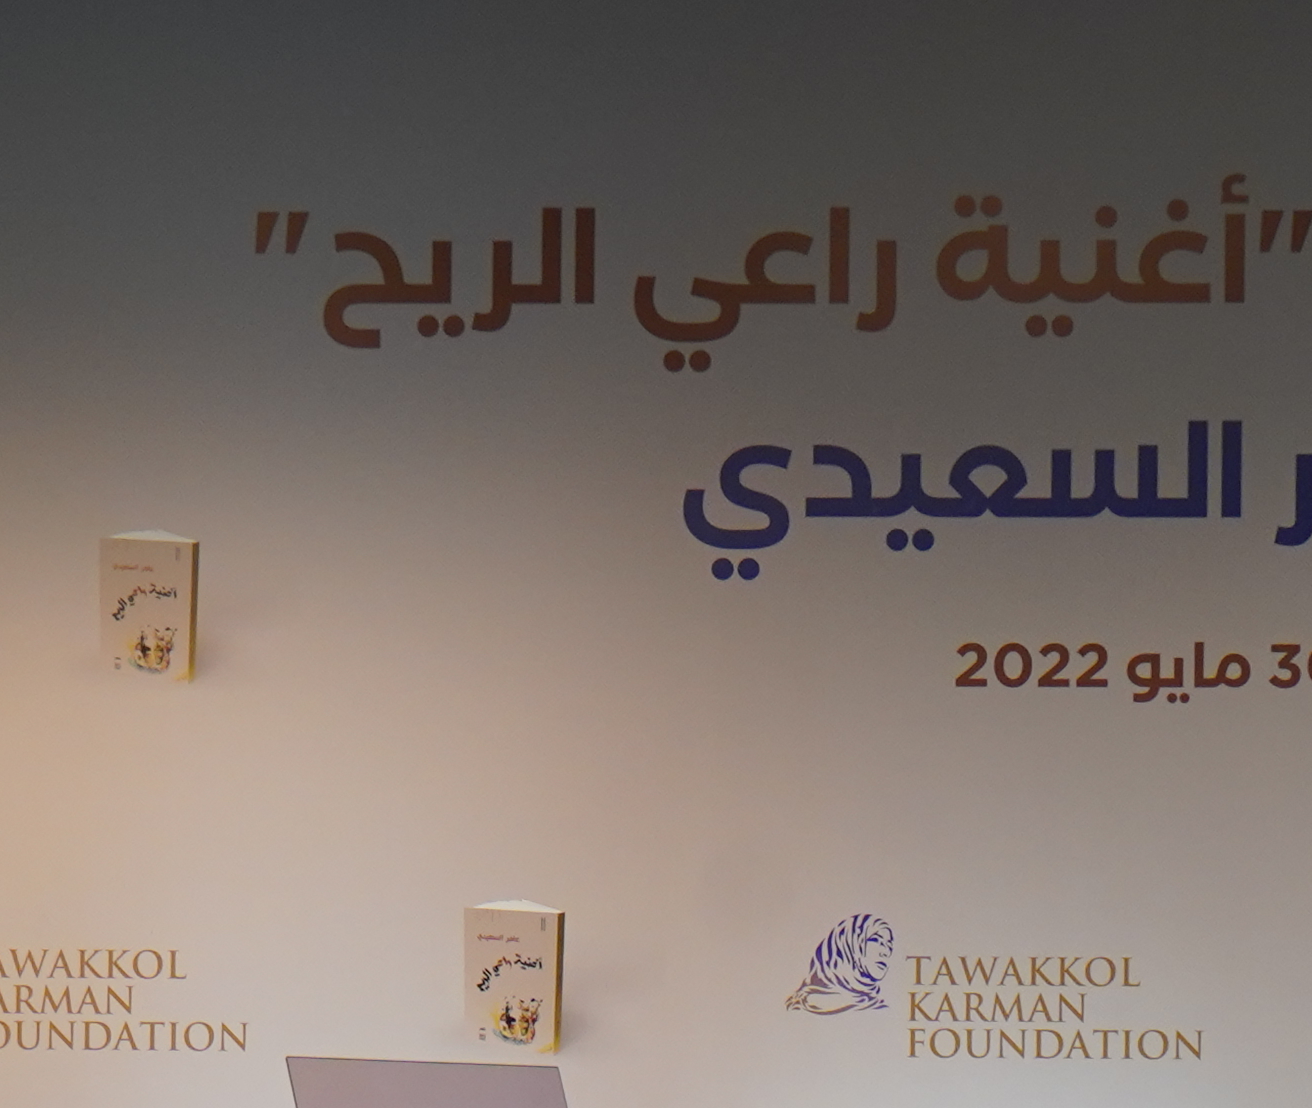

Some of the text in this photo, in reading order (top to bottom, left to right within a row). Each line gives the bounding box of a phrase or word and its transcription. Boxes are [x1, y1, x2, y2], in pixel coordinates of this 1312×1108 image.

[634, 207, 897, 373] راعي
[683, 420, 1242, 581] السعيدي
[955, 643, 1108, 688] 2022
[1127, 642, 1251, 703] مايو
[905, 955, 1141, 988] TAWAKKOL
[909, 991, 1086, 1023] KARMAN
[908, 1027, 1203, 1061] FOUNDATION
